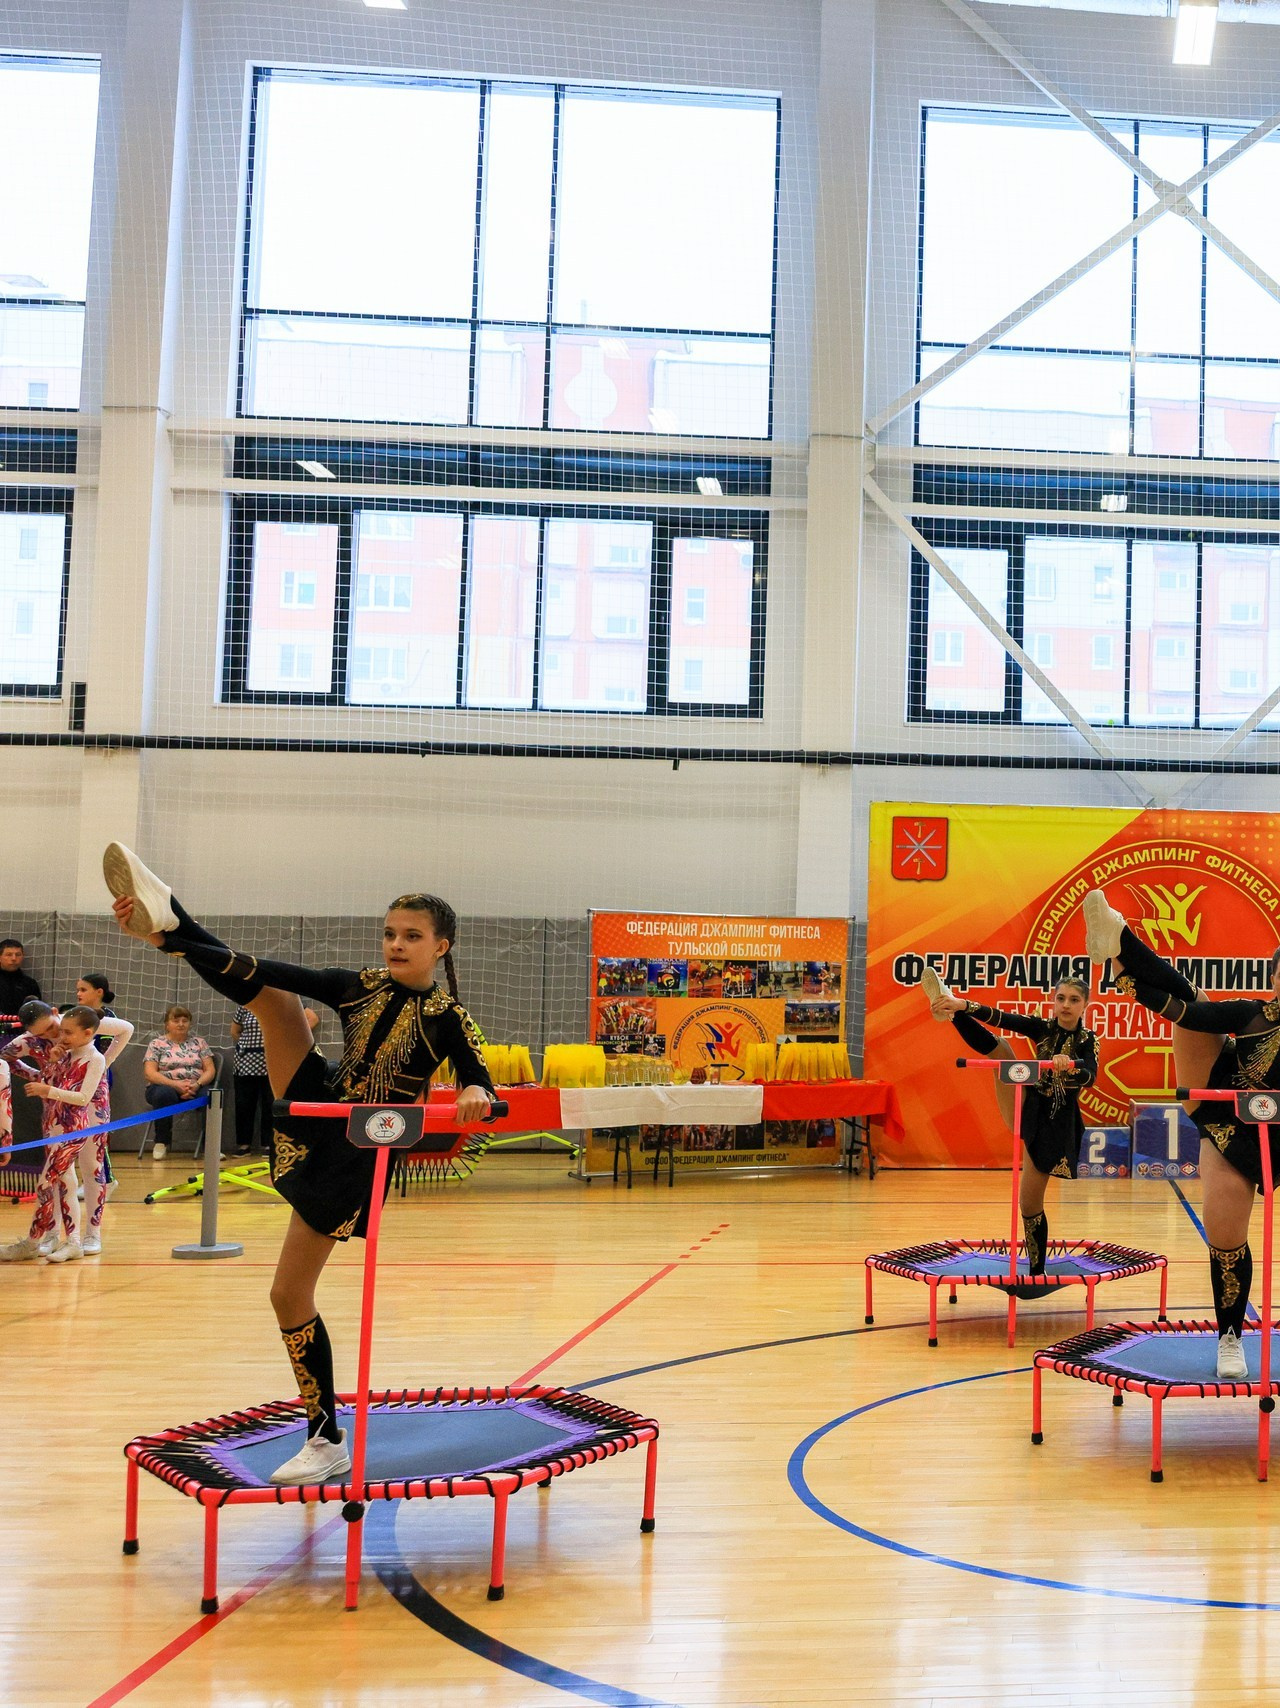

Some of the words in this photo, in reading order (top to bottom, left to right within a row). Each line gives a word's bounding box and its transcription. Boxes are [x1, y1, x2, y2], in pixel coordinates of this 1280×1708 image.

[1033, 878, 1089, 955] ДЕРАЦИЯ
[1092, 847, 1200, 885] ДЖАМПИНГ
[1205, 855, 1279, 912] ФИТНЕСА
[626, 921, 698, 937] ФЕДЕРАЦИЯ
[700, 923, 767, 938] ДЖАМПИНГ
[769, 925, 821, 939] ФИТНЕСА
[668, 940, 728, 957] ТУЛЬСКОЙ
[730, 943, 782, 957] ОБЛАСТИ
[894, 953, 1091, 994] ФЕДЕРАЦИЯ
[756, 1025, 767, 1043] РОСС
[1164, 1108, 1179, 1160] 1
[715, 1154, 754, 1164] ДЖАМПИНГ
[1089, 1131, 1106, 1163] 2
